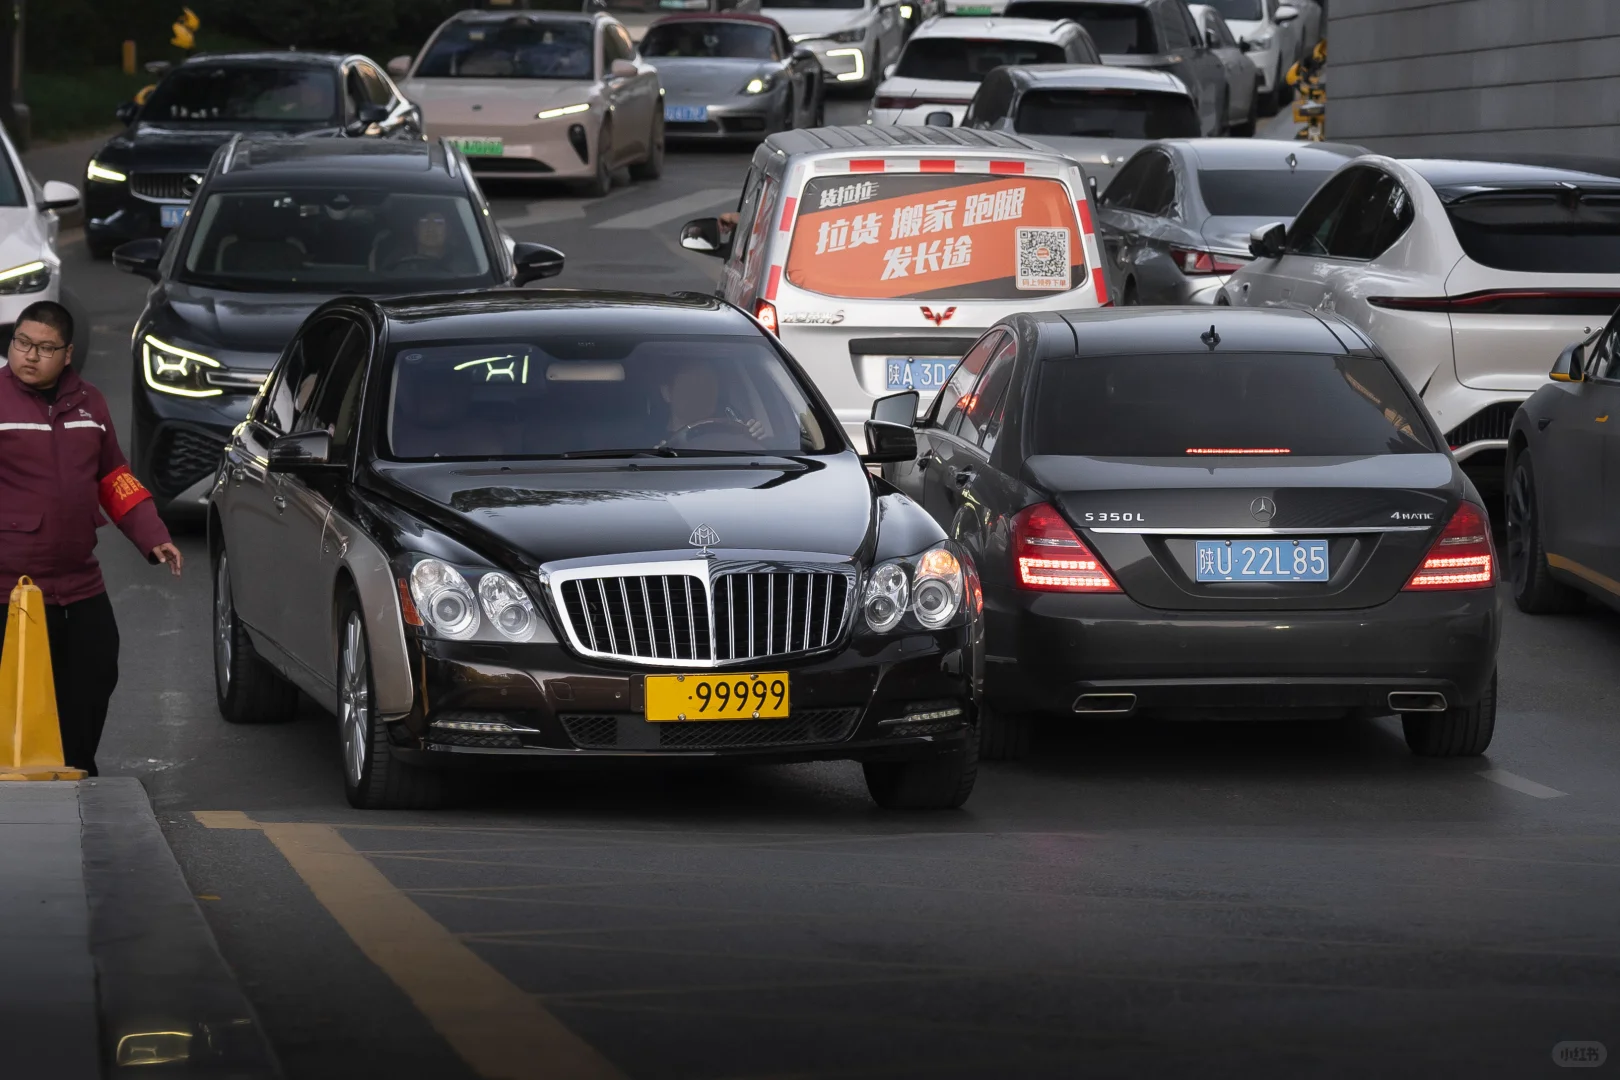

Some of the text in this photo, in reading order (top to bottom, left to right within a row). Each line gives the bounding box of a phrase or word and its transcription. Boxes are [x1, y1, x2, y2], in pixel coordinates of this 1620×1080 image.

[819, 181, 878, 209] 货拉拉
[815, 187, 1026, 255] 拉货 搬家 跑腿
[880, 235, 972, 281] 发长途
[1200, 546, 1325, 575] 陕U·22L85
